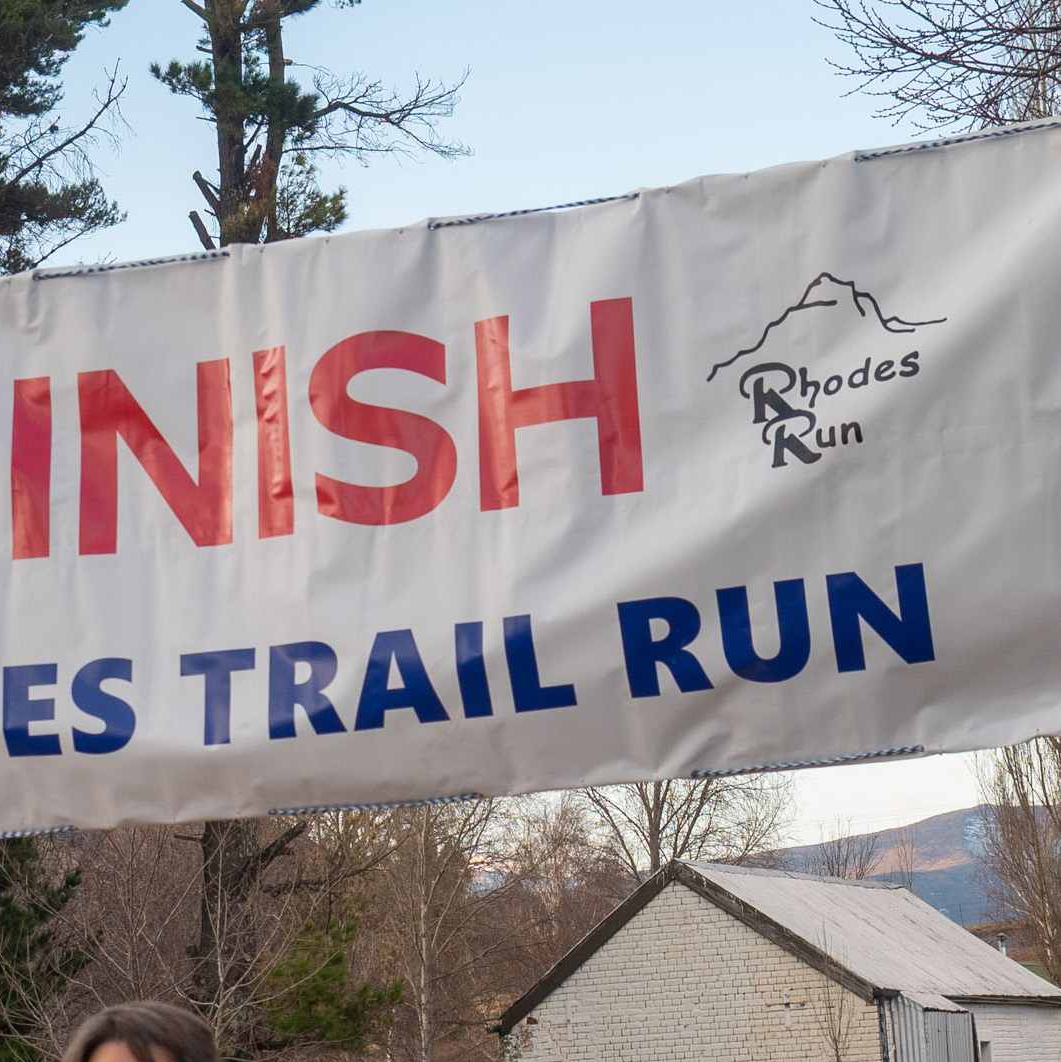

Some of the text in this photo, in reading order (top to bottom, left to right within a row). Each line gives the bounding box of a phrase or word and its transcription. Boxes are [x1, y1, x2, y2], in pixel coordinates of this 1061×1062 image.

[739, 350, 920, 424] Rhodes
[762, 409, 864, 468] Run
[179, 614, 578, 746] TRAIL
[617, 562, 936, 698] RUN
